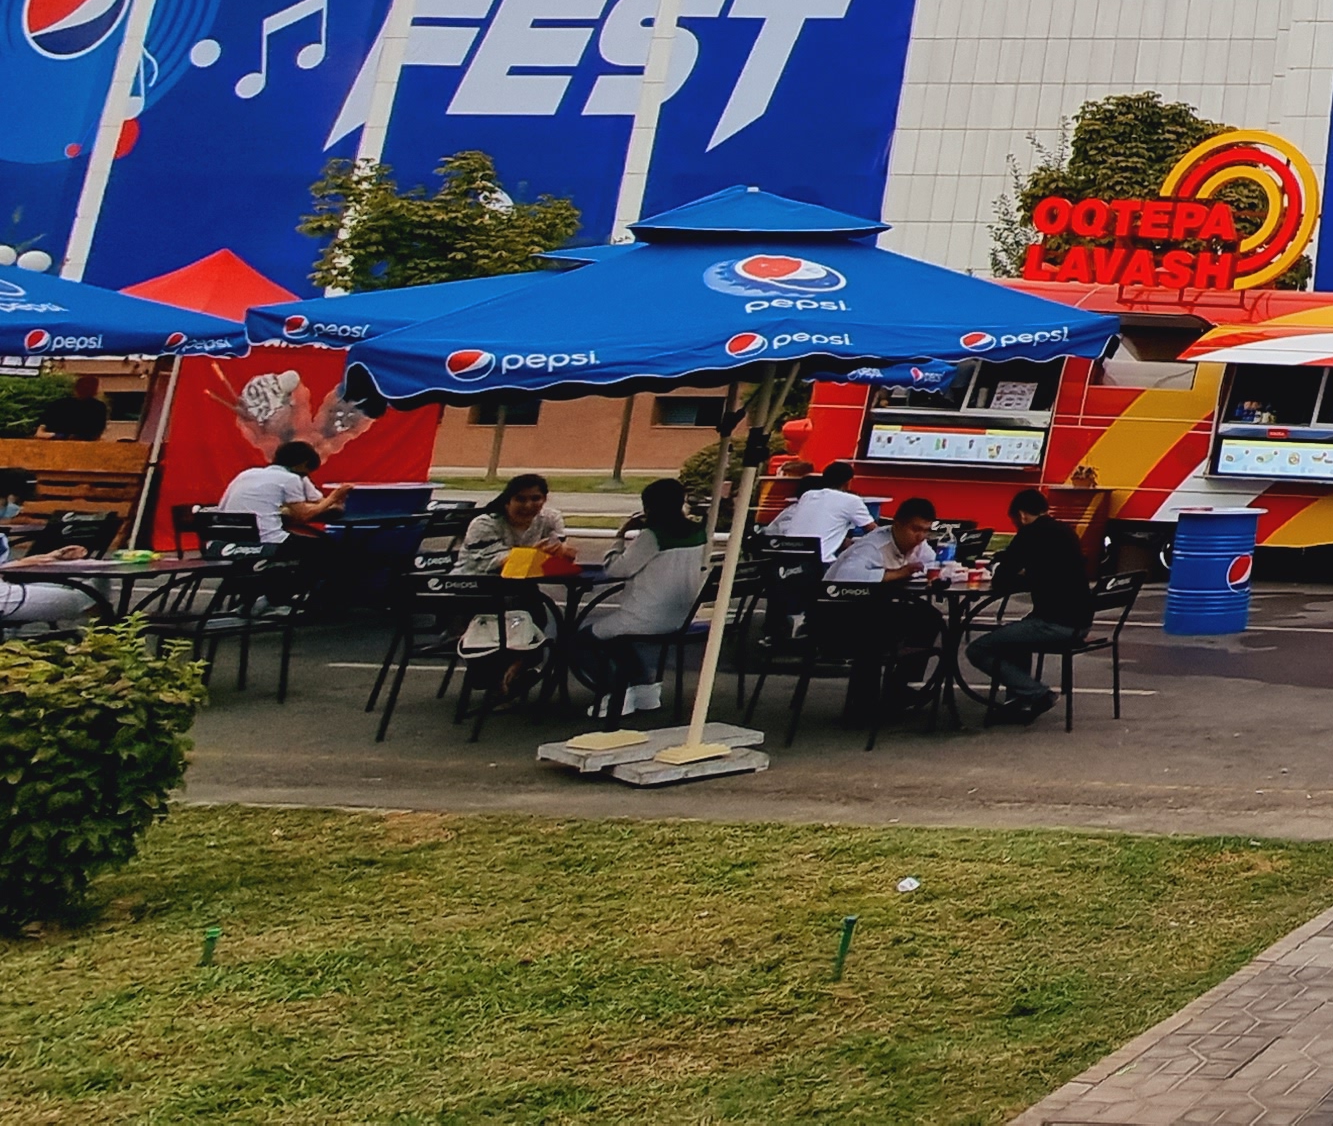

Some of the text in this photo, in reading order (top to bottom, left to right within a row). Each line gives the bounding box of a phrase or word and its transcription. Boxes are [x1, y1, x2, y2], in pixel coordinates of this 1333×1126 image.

[1033, 196, 1237, 241] OQTEPA
[1023, 243, 1235, 291] LAVASH
[744, 298, 847, 313] pepsi
[51, 334, 102, 351] pepsi
[773, 332, 850, 349] pepsi
[1000, 327, 1070, 347] pepsi
[502, 350, 597, 375] pepsi
